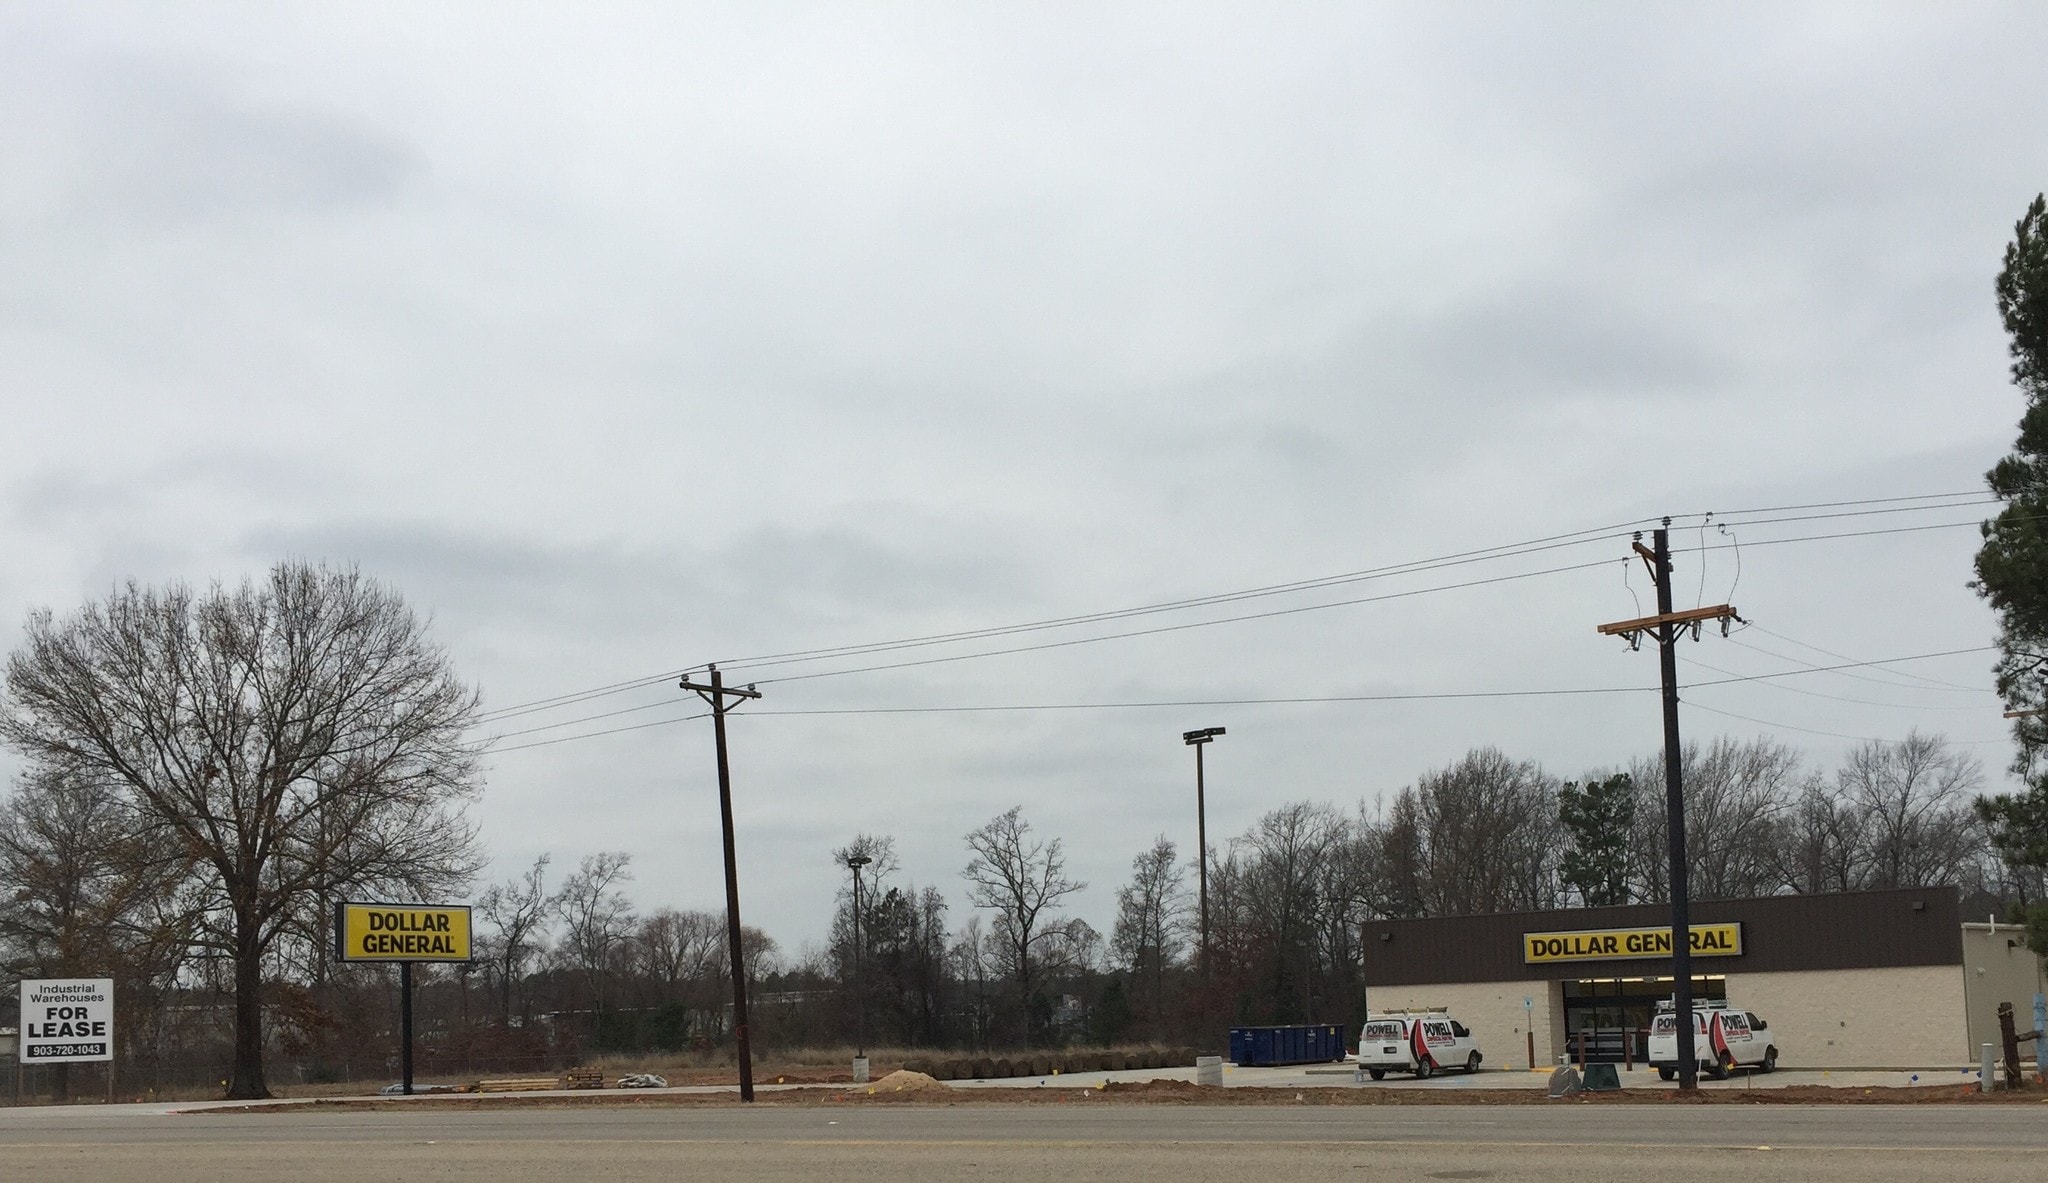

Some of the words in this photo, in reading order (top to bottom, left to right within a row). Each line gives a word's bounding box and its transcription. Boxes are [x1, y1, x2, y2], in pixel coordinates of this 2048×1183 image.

[368, 912, 450, 932] DOLLAR
[362, 934, 456, 954] GENERAL
[1531, 935, 1618, 957] DOLLAR
[1625, 930, 1732, 953] GENRAL
[39, 984, 95, 993] Industrial
[30, 994, 104, 1002] Warehouses
[46, 1007, 88, 1020] FOR
[1423, 1022, 1452, 1036] POWELL
[1720, 1014, 1748, 1030] POWELL
[28, 1021, 106, 1038] LEASE
[1366, 1024, 1398, 1035] POWELL
[33, 1044, 100, 1056] 903-720-1043
